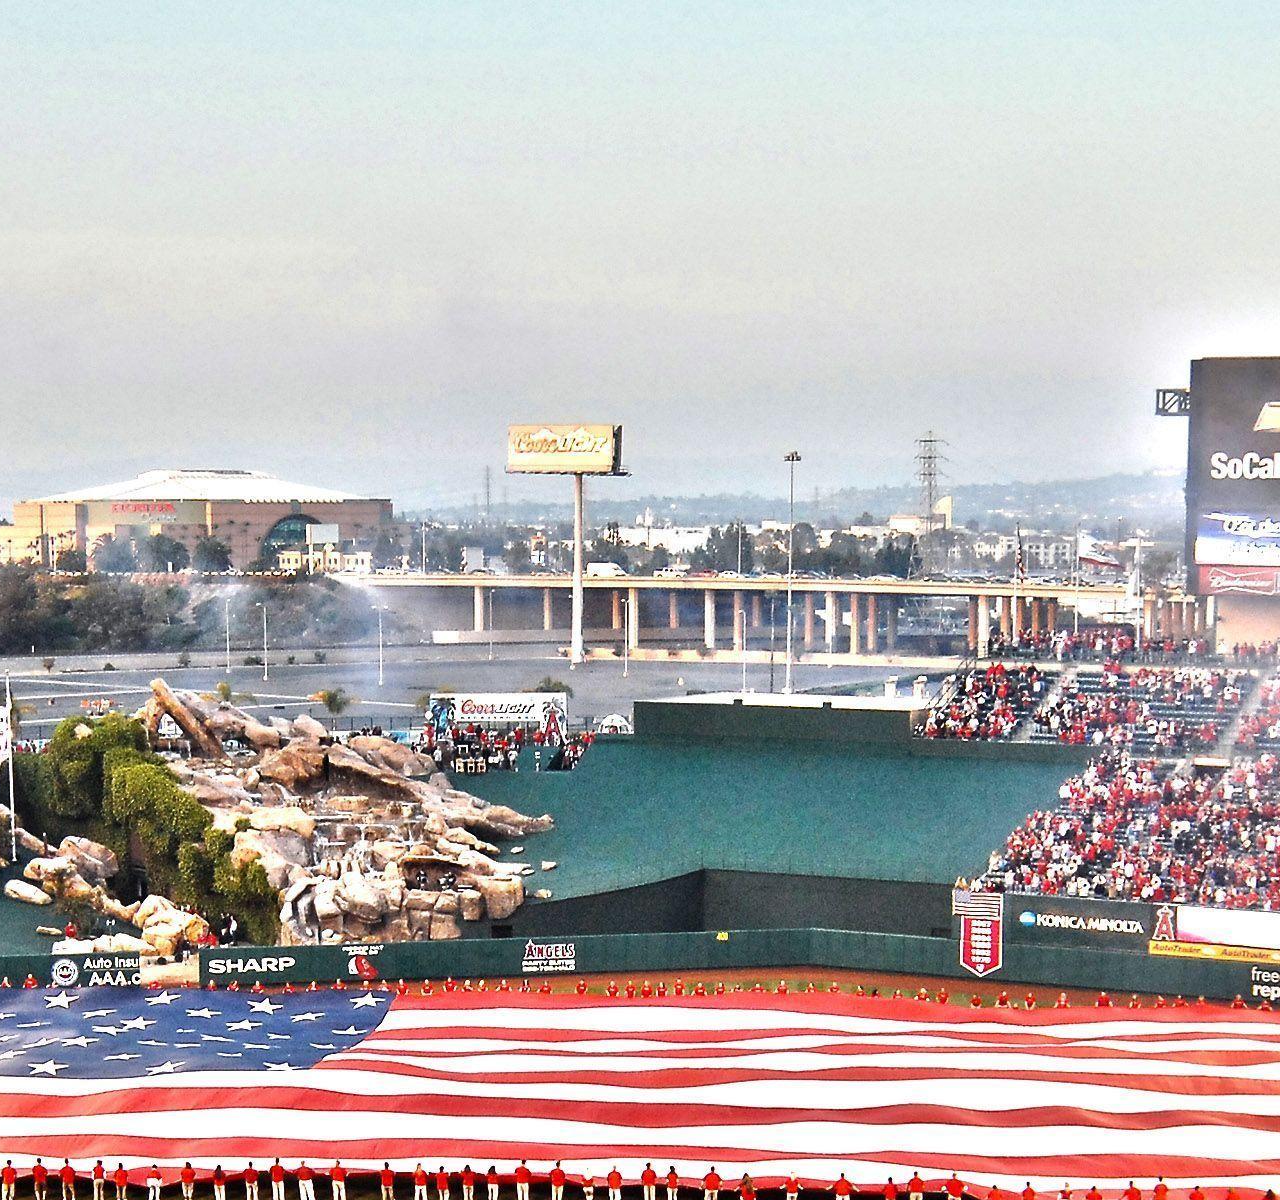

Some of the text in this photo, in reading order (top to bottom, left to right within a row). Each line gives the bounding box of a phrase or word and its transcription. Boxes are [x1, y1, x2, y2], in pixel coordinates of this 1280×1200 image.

[1037, 914, 1144, 934] KONICA MINOLTA
[523, 939, 576, 960] ANGELS
[1152, 944, 1201, 955] AutoTrader
[1221, 949, 1271, 960] AutoTrader
[83, 957, 113, 969] Auto
[209, 956, 295, 974] SHARP
